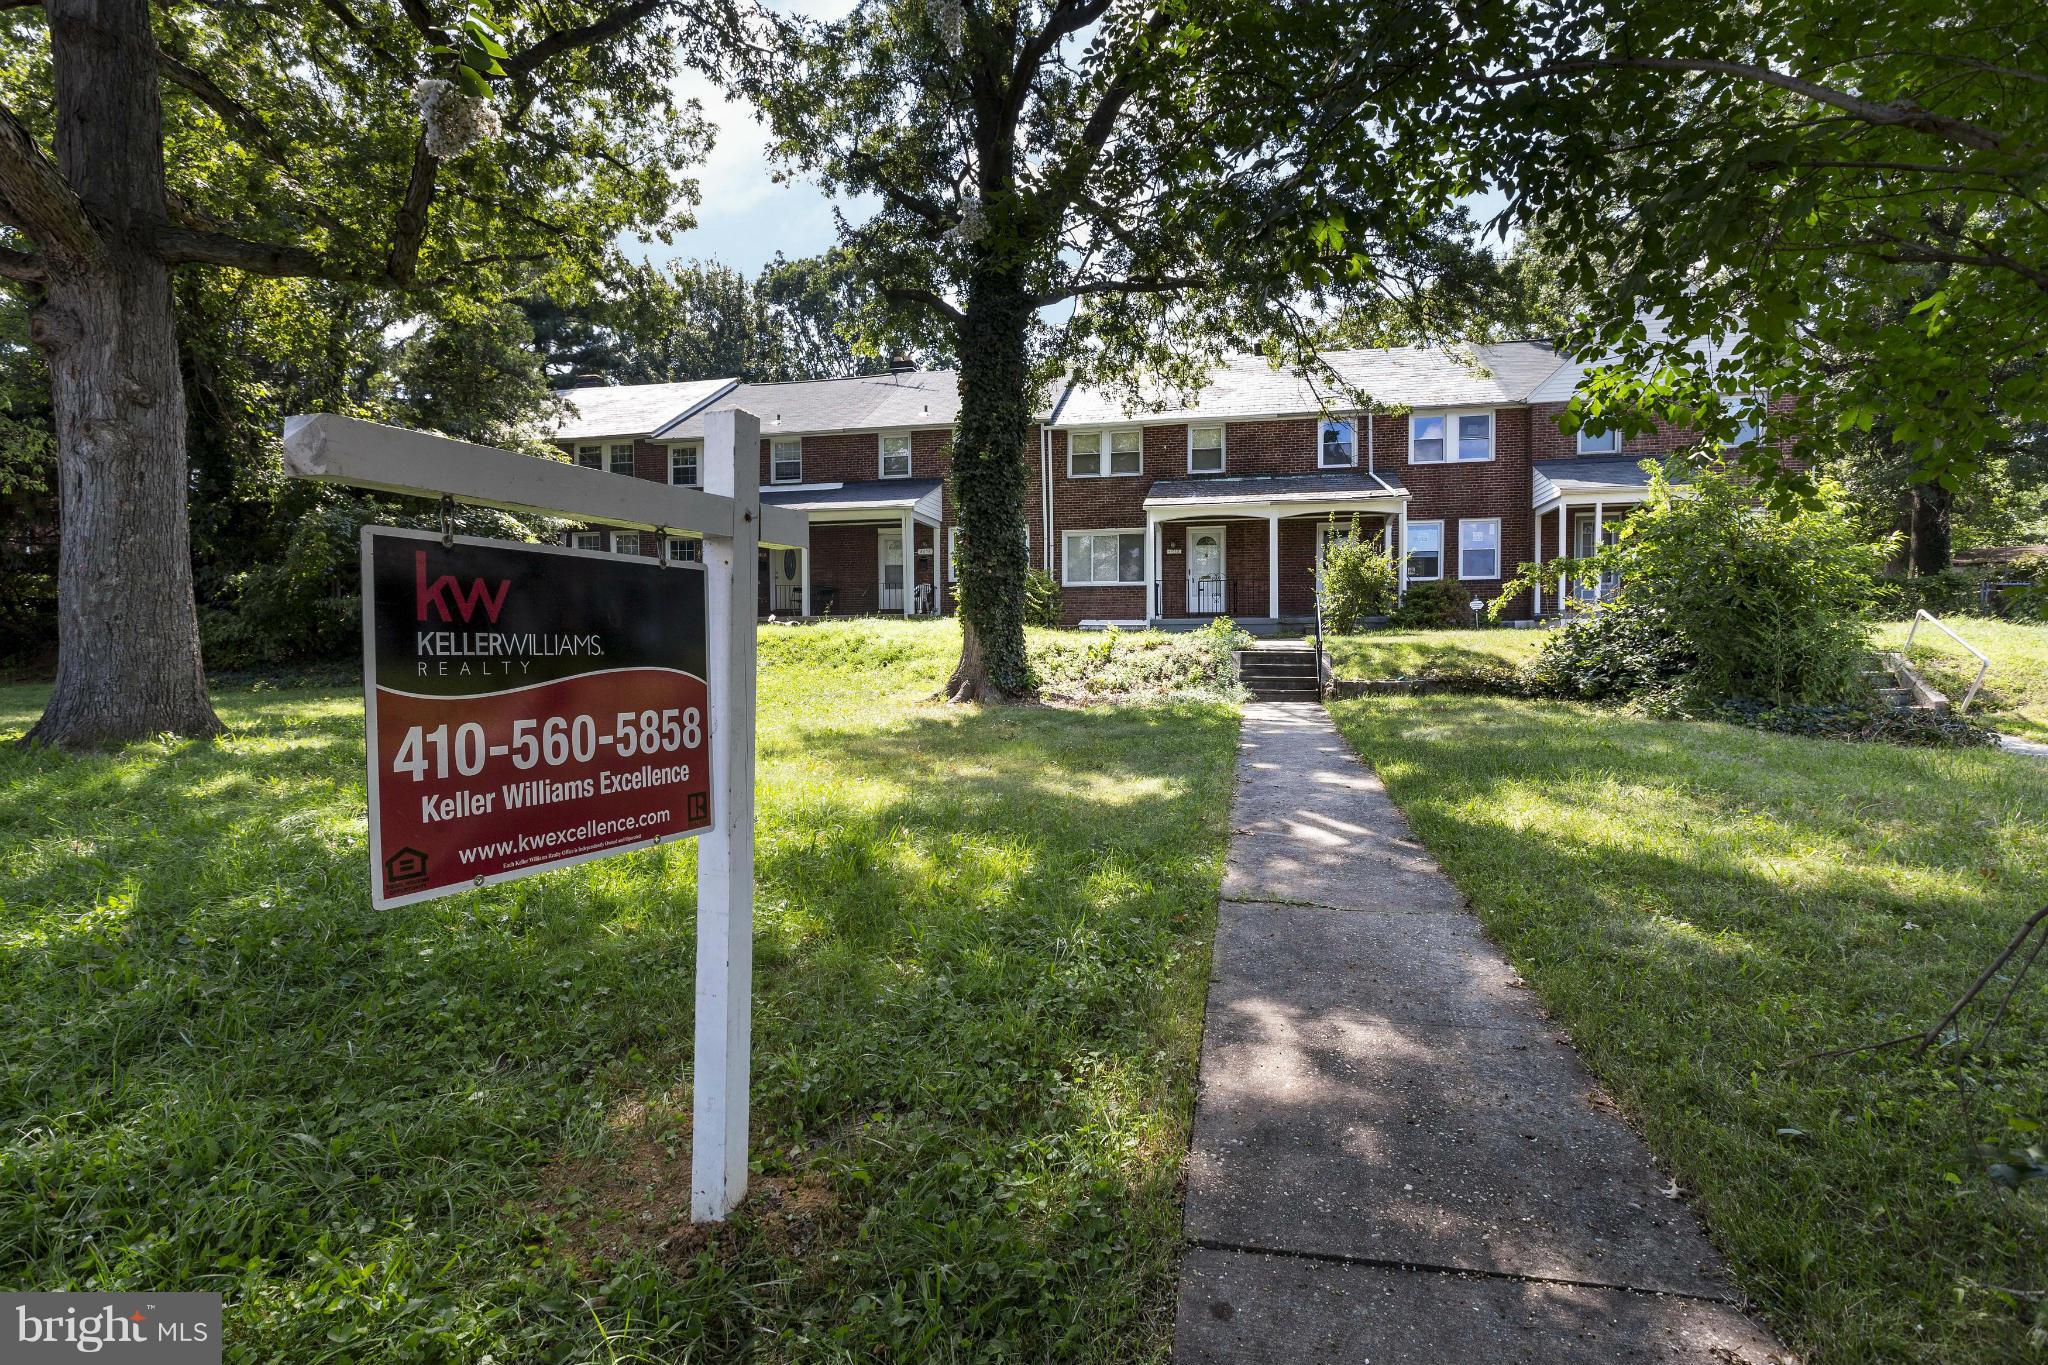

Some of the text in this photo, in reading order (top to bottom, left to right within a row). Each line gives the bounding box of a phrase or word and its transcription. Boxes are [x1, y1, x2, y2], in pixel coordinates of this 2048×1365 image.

[415, 551, 512, 624] kw
[418, 660, 531, 677] REALTY
[393, 706, 702, 782] 410-560-5858
[421, 764, 690, 824] Keller Williams Excellence
[458, 807, 671, 865] www.kwexcellence.com
